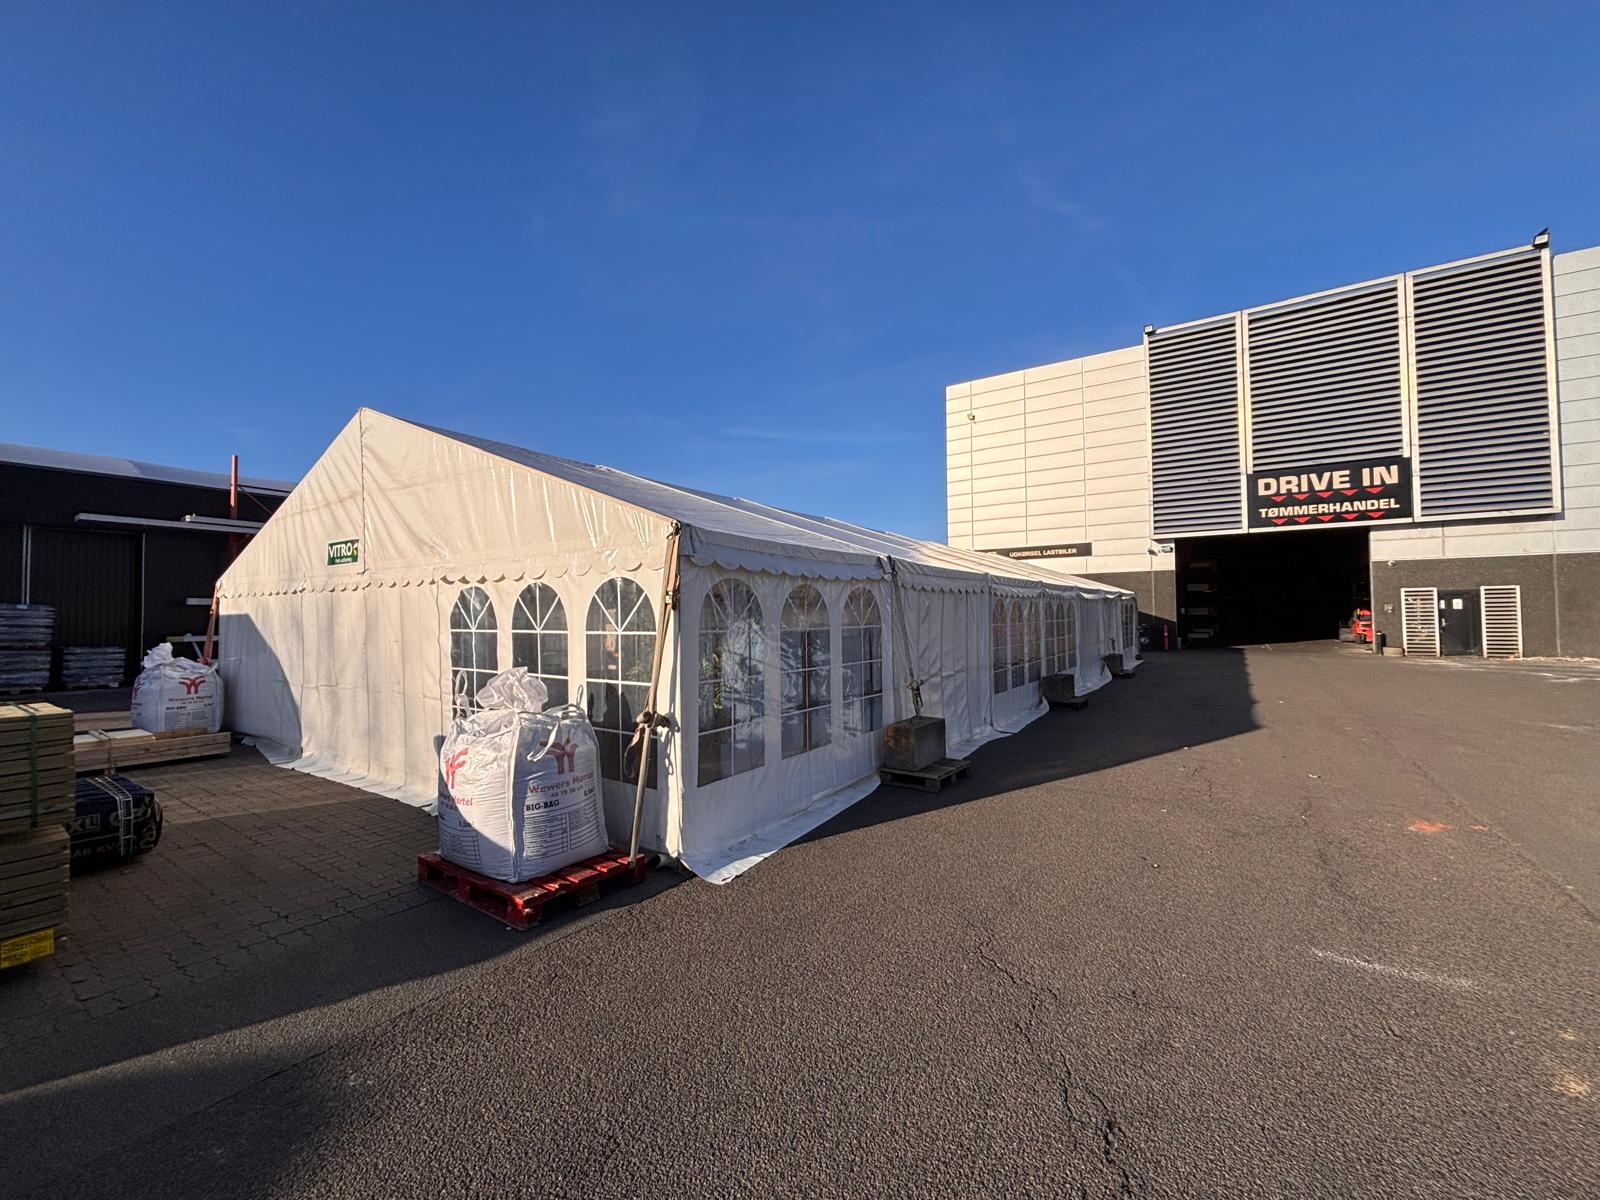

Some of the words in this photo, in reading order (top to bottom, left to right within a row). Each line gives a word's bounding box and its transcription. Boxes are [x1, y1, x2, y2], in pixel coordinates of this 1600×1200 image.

[1257, 469, 1352, 496] DRIVE
[1362, 464, 1399, 487] IN
[1258, 498, 1401, 518] TØMMERHANDEL
[328, 542, 353, 558] VITRO
[1043, 547, 1077, 556] LASTBILER
[525, 799, 560, 811] BIG-BAG
